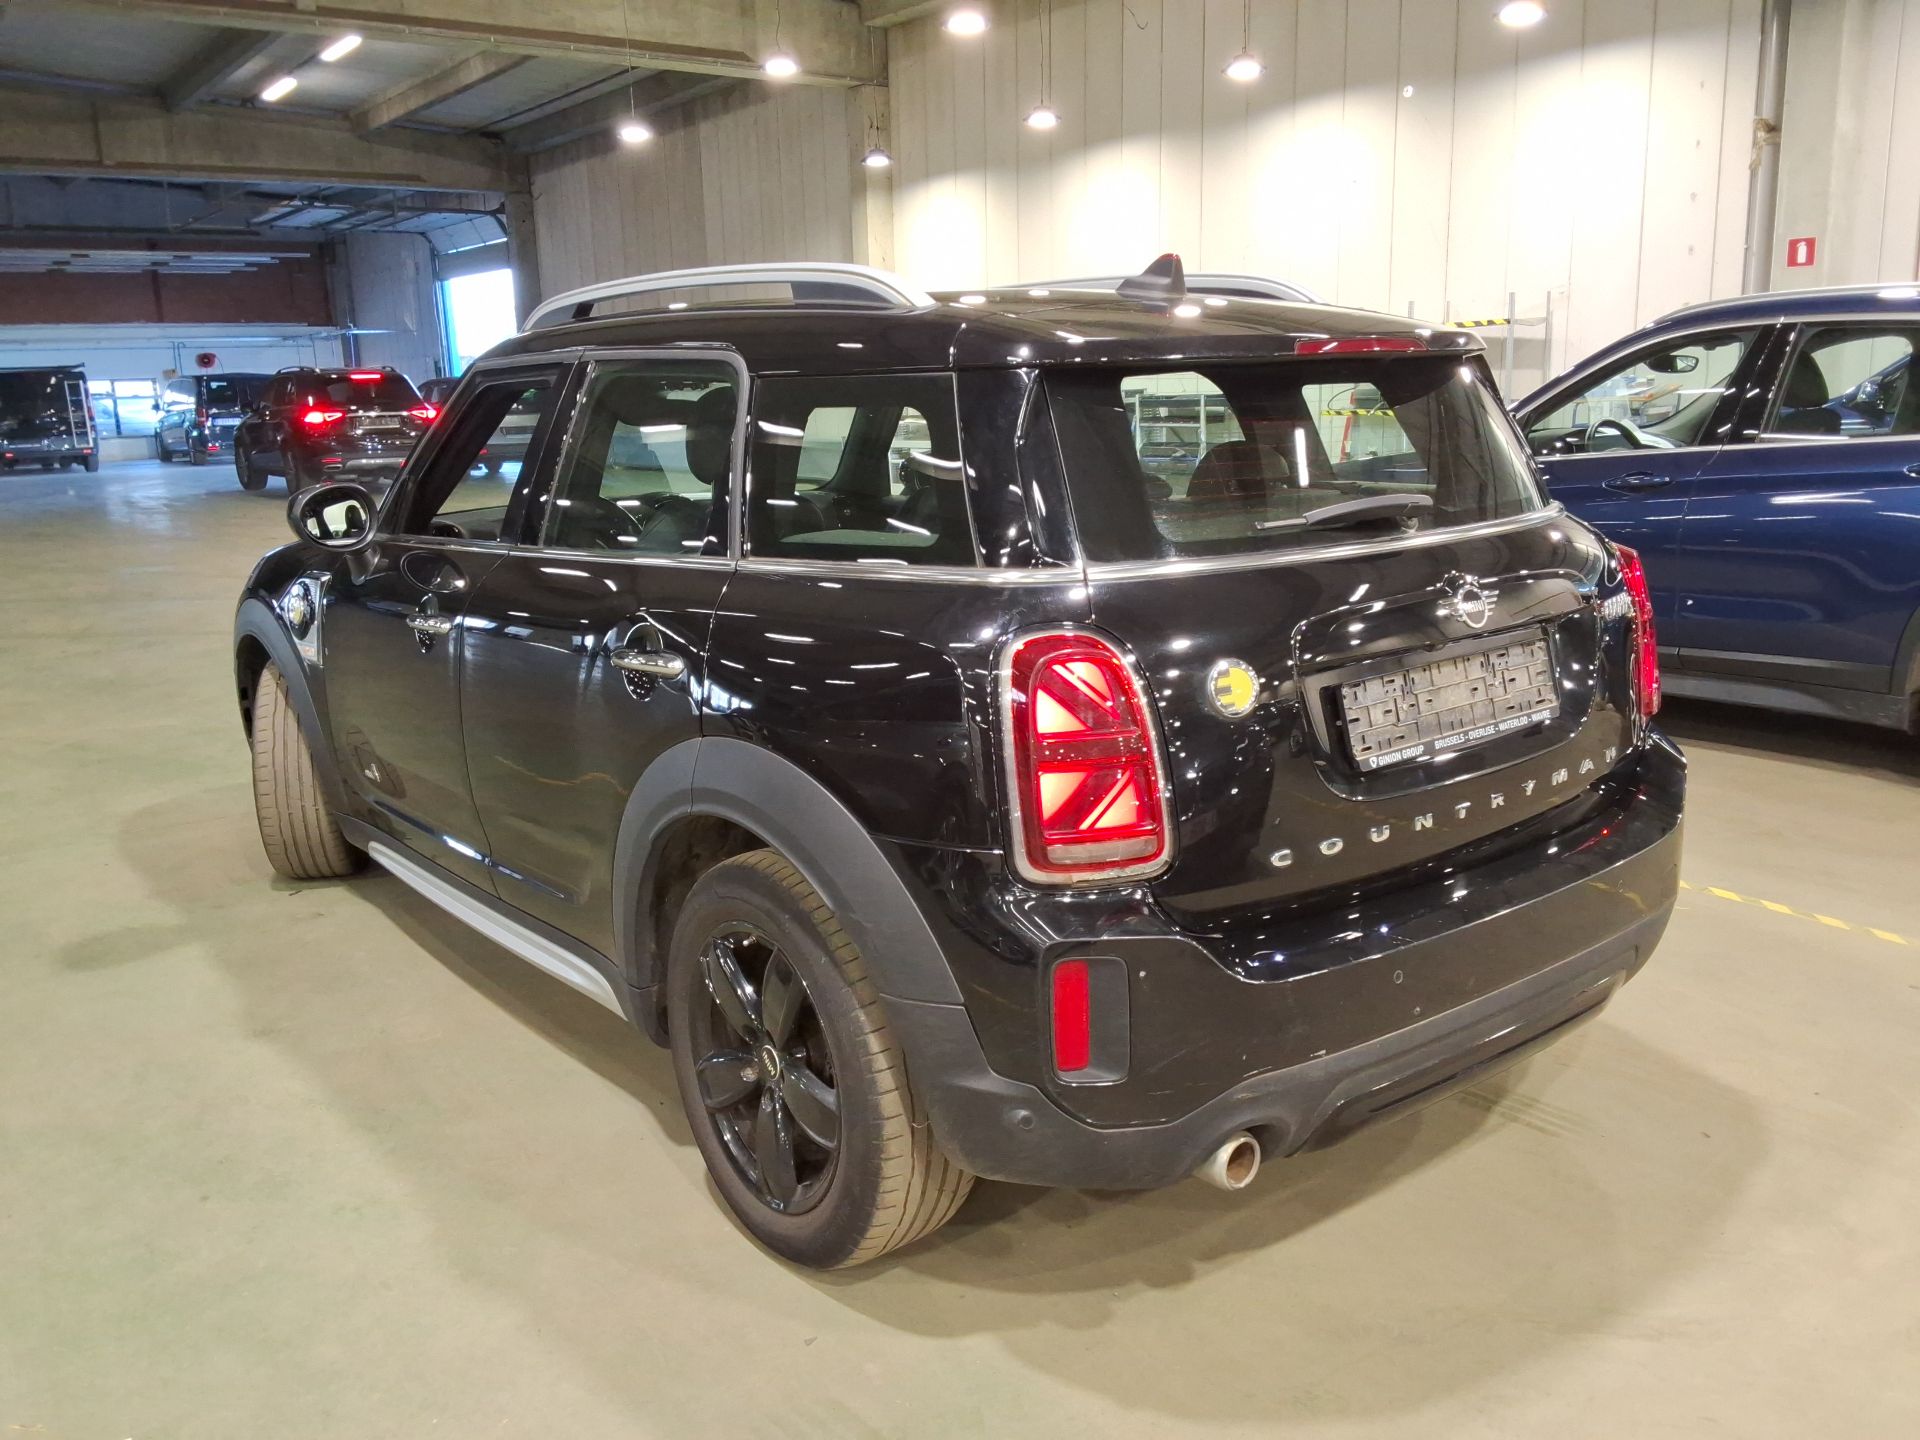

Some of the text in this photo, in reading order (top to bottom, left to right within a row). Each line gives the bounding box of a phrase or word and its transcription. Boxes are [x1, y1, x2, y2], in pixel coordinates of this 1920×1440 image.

[1434, 733, 1465, 749] BRUSSELS
[1468, 725, 1496, 740] OVERIJSE
[1498, 716, 1528, 731] WATERLOO
[1531, 709, 1551, 722] WAVRE
[1378, 745, 1424, 765] GINION GROUP
[1270, 746, 1617, 862] COUNTRYMAN
